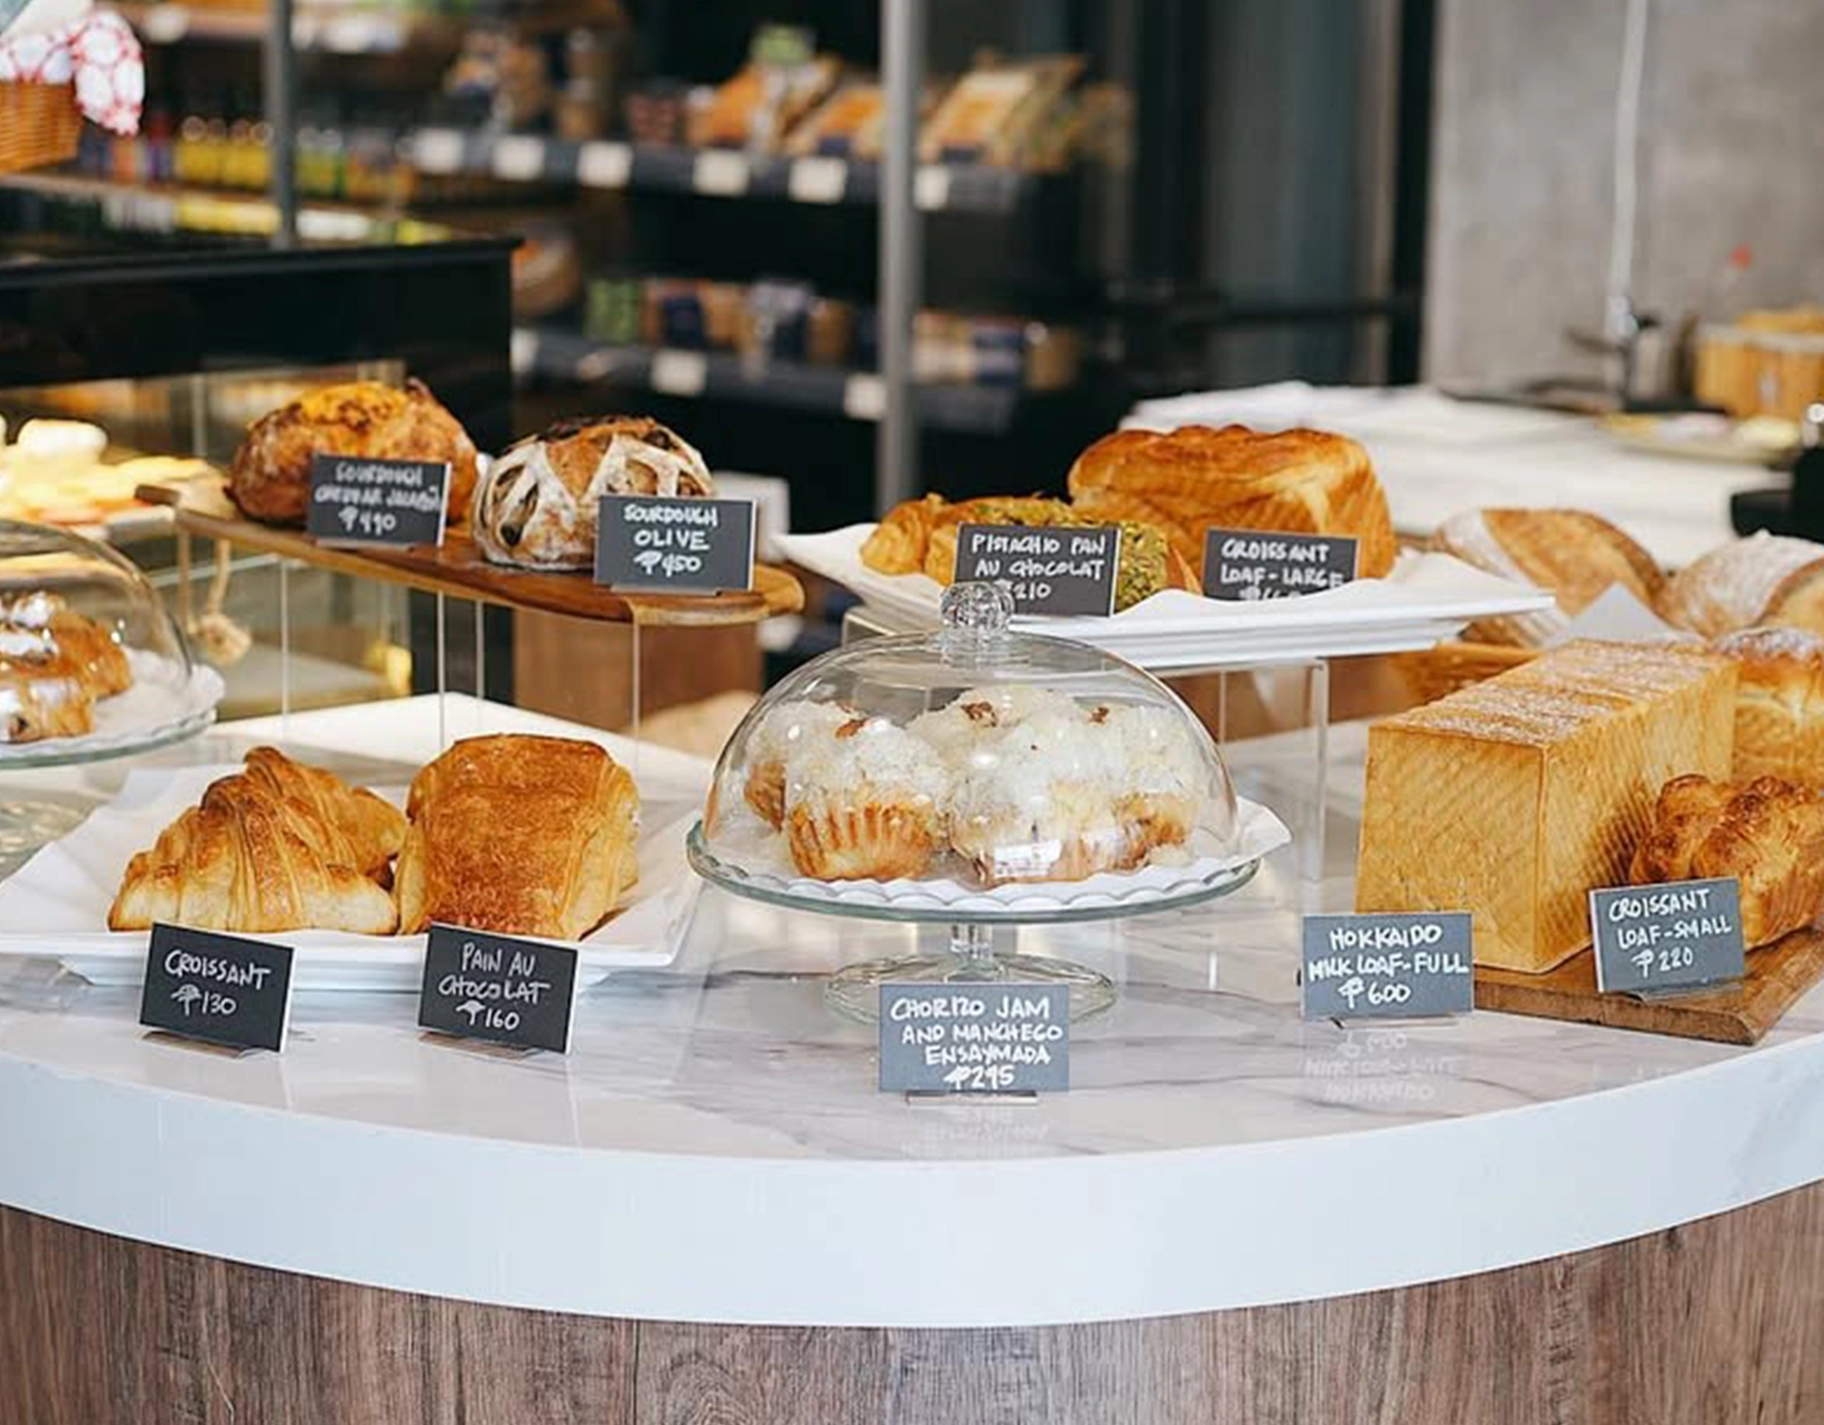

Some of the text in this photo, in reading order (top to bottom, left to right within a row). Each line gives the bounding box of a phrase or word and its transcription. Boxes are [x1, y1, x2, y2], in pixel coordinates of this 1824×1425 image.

[624, 503, 718, 527] SOURDOUGH
[634, 529, 711, 550] OLIVE
[971, 533, 1105, 555] PISTACHIO PAN
[1220, 538, 1330, 562] CROISSANT
[974, 558, 1105, 580] AU CHOCOLAT
[1608, 888, 1710, 921] CROISSANT
[1329, 924, 1443, 951] HOKKAIDO
[164, 949, 272, 990] CROISSANT
[461, 942, 536, 977] PAIN AU
[1308, 957, 1354, 982] MILK
[438, 974, 551, 1004] CHOCOLAT
[890, 995, 1050, 1020] CHORIZO JAM
[902, 1022, 1063, 1045] AND MANCHEGO
[924, 1044, 1051, 1066] ENSAYMADA
